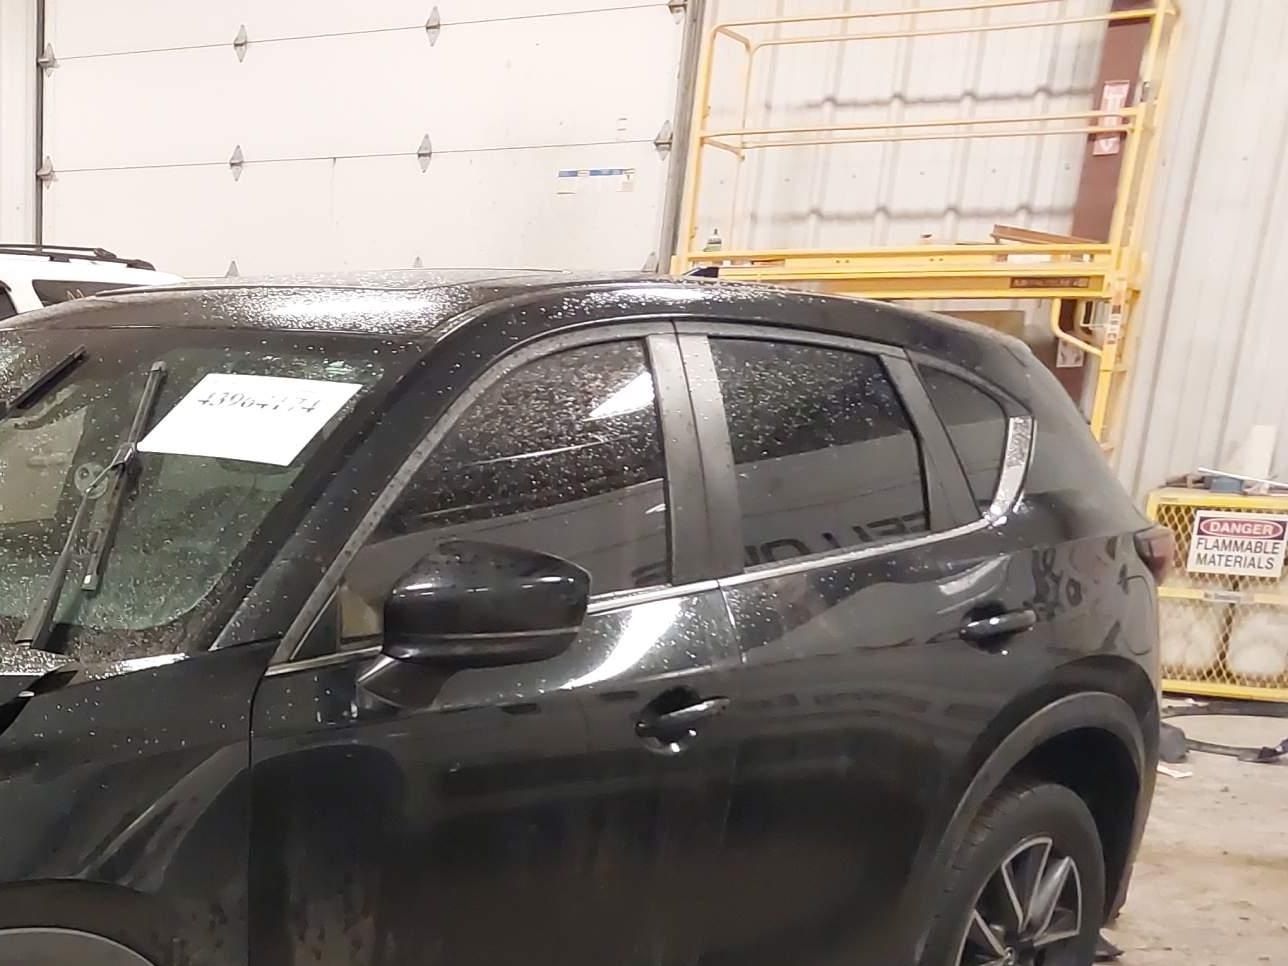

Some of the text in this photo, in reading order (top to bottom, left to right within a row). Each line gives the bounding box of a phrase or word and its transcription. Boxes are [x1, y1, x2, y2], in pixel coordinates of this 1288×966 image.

[1209, 521, 1274, 535] DANGER
[1196, 538, 1281, 554] FLAMMABLE
[1196, 552, 1275, 569] MATERIALS
